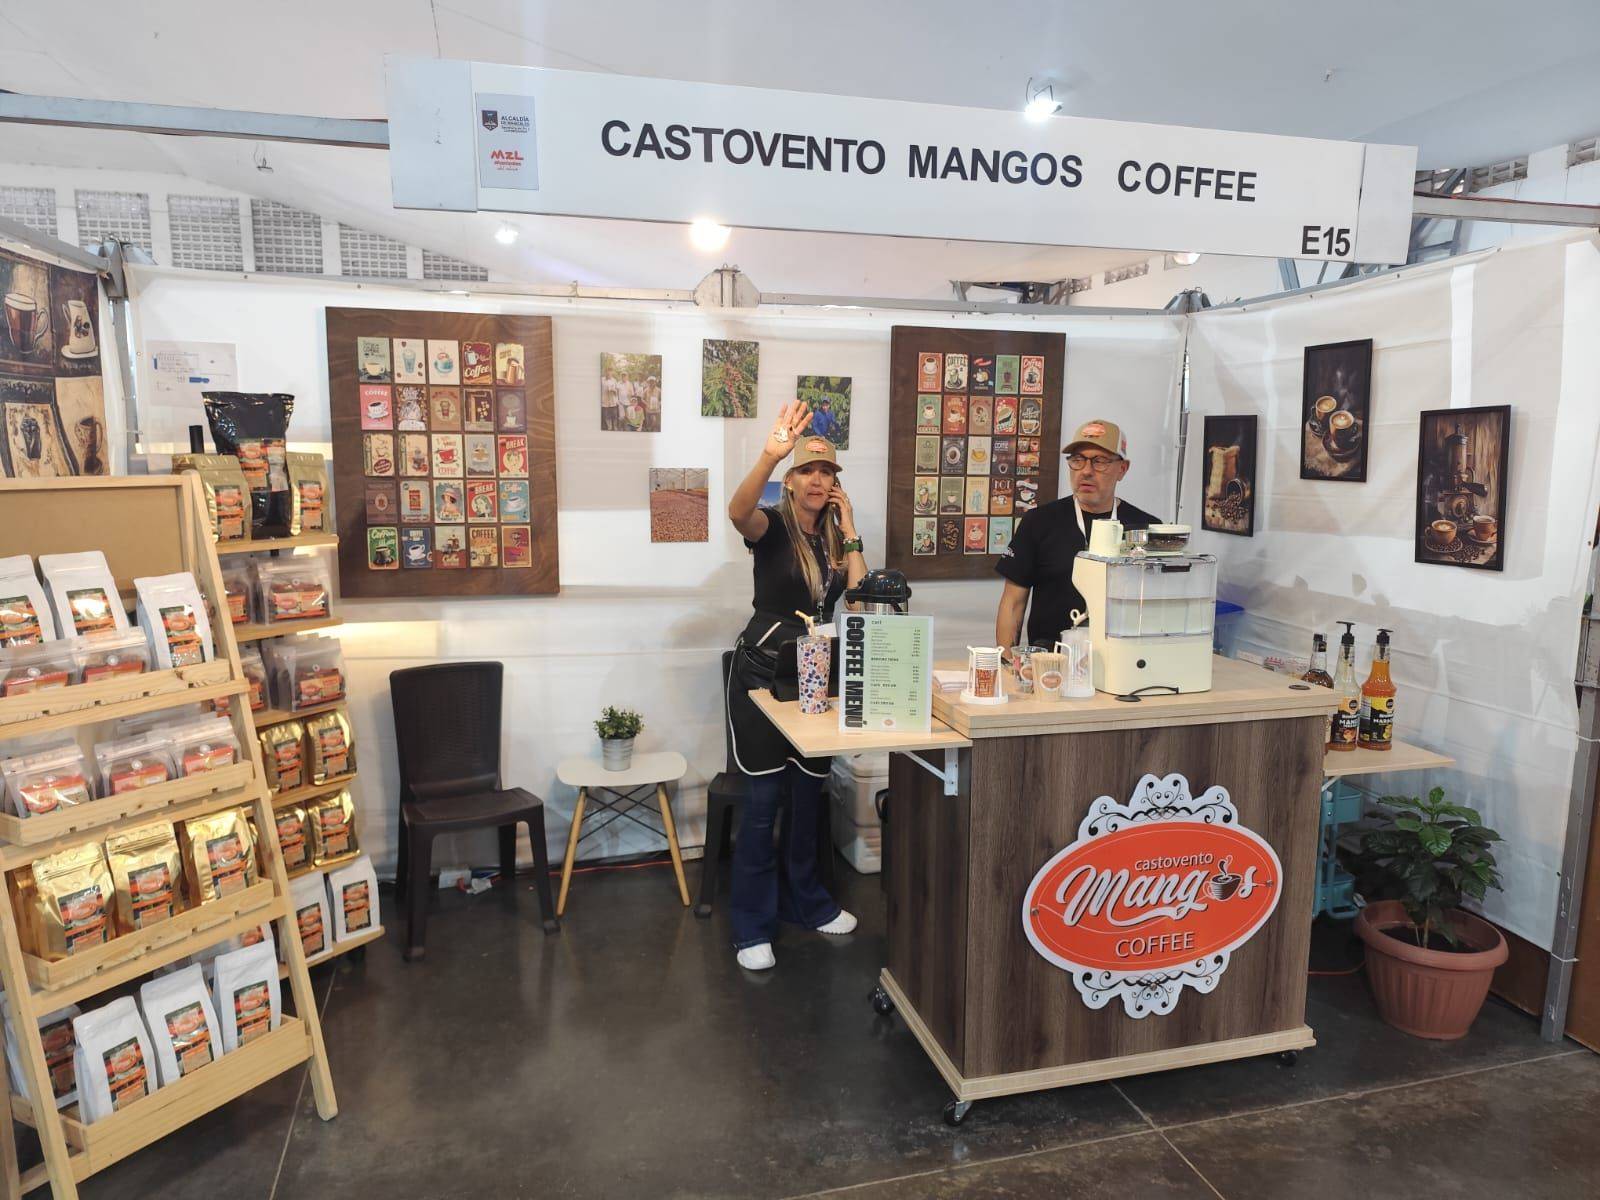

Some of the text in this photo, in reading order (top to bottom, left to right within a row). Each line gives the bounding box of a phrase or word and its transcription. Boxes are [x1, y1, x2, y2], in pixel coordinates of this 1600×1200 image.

[601, 119, 1257, 202] CASTOVENTO MANGOS COFFEE
[1301, 225, 1351, 257] E15
[464, 365, 490, 378] Coffee
[364, 389, 388, 397] COFFEE
[471, 528, 496, 538] COFFEE
[846, 616, 865, 677] COFFEE
[1134, 851, 1214, 871] castovento
[1115, 931, 1196, 957] COFFEE
